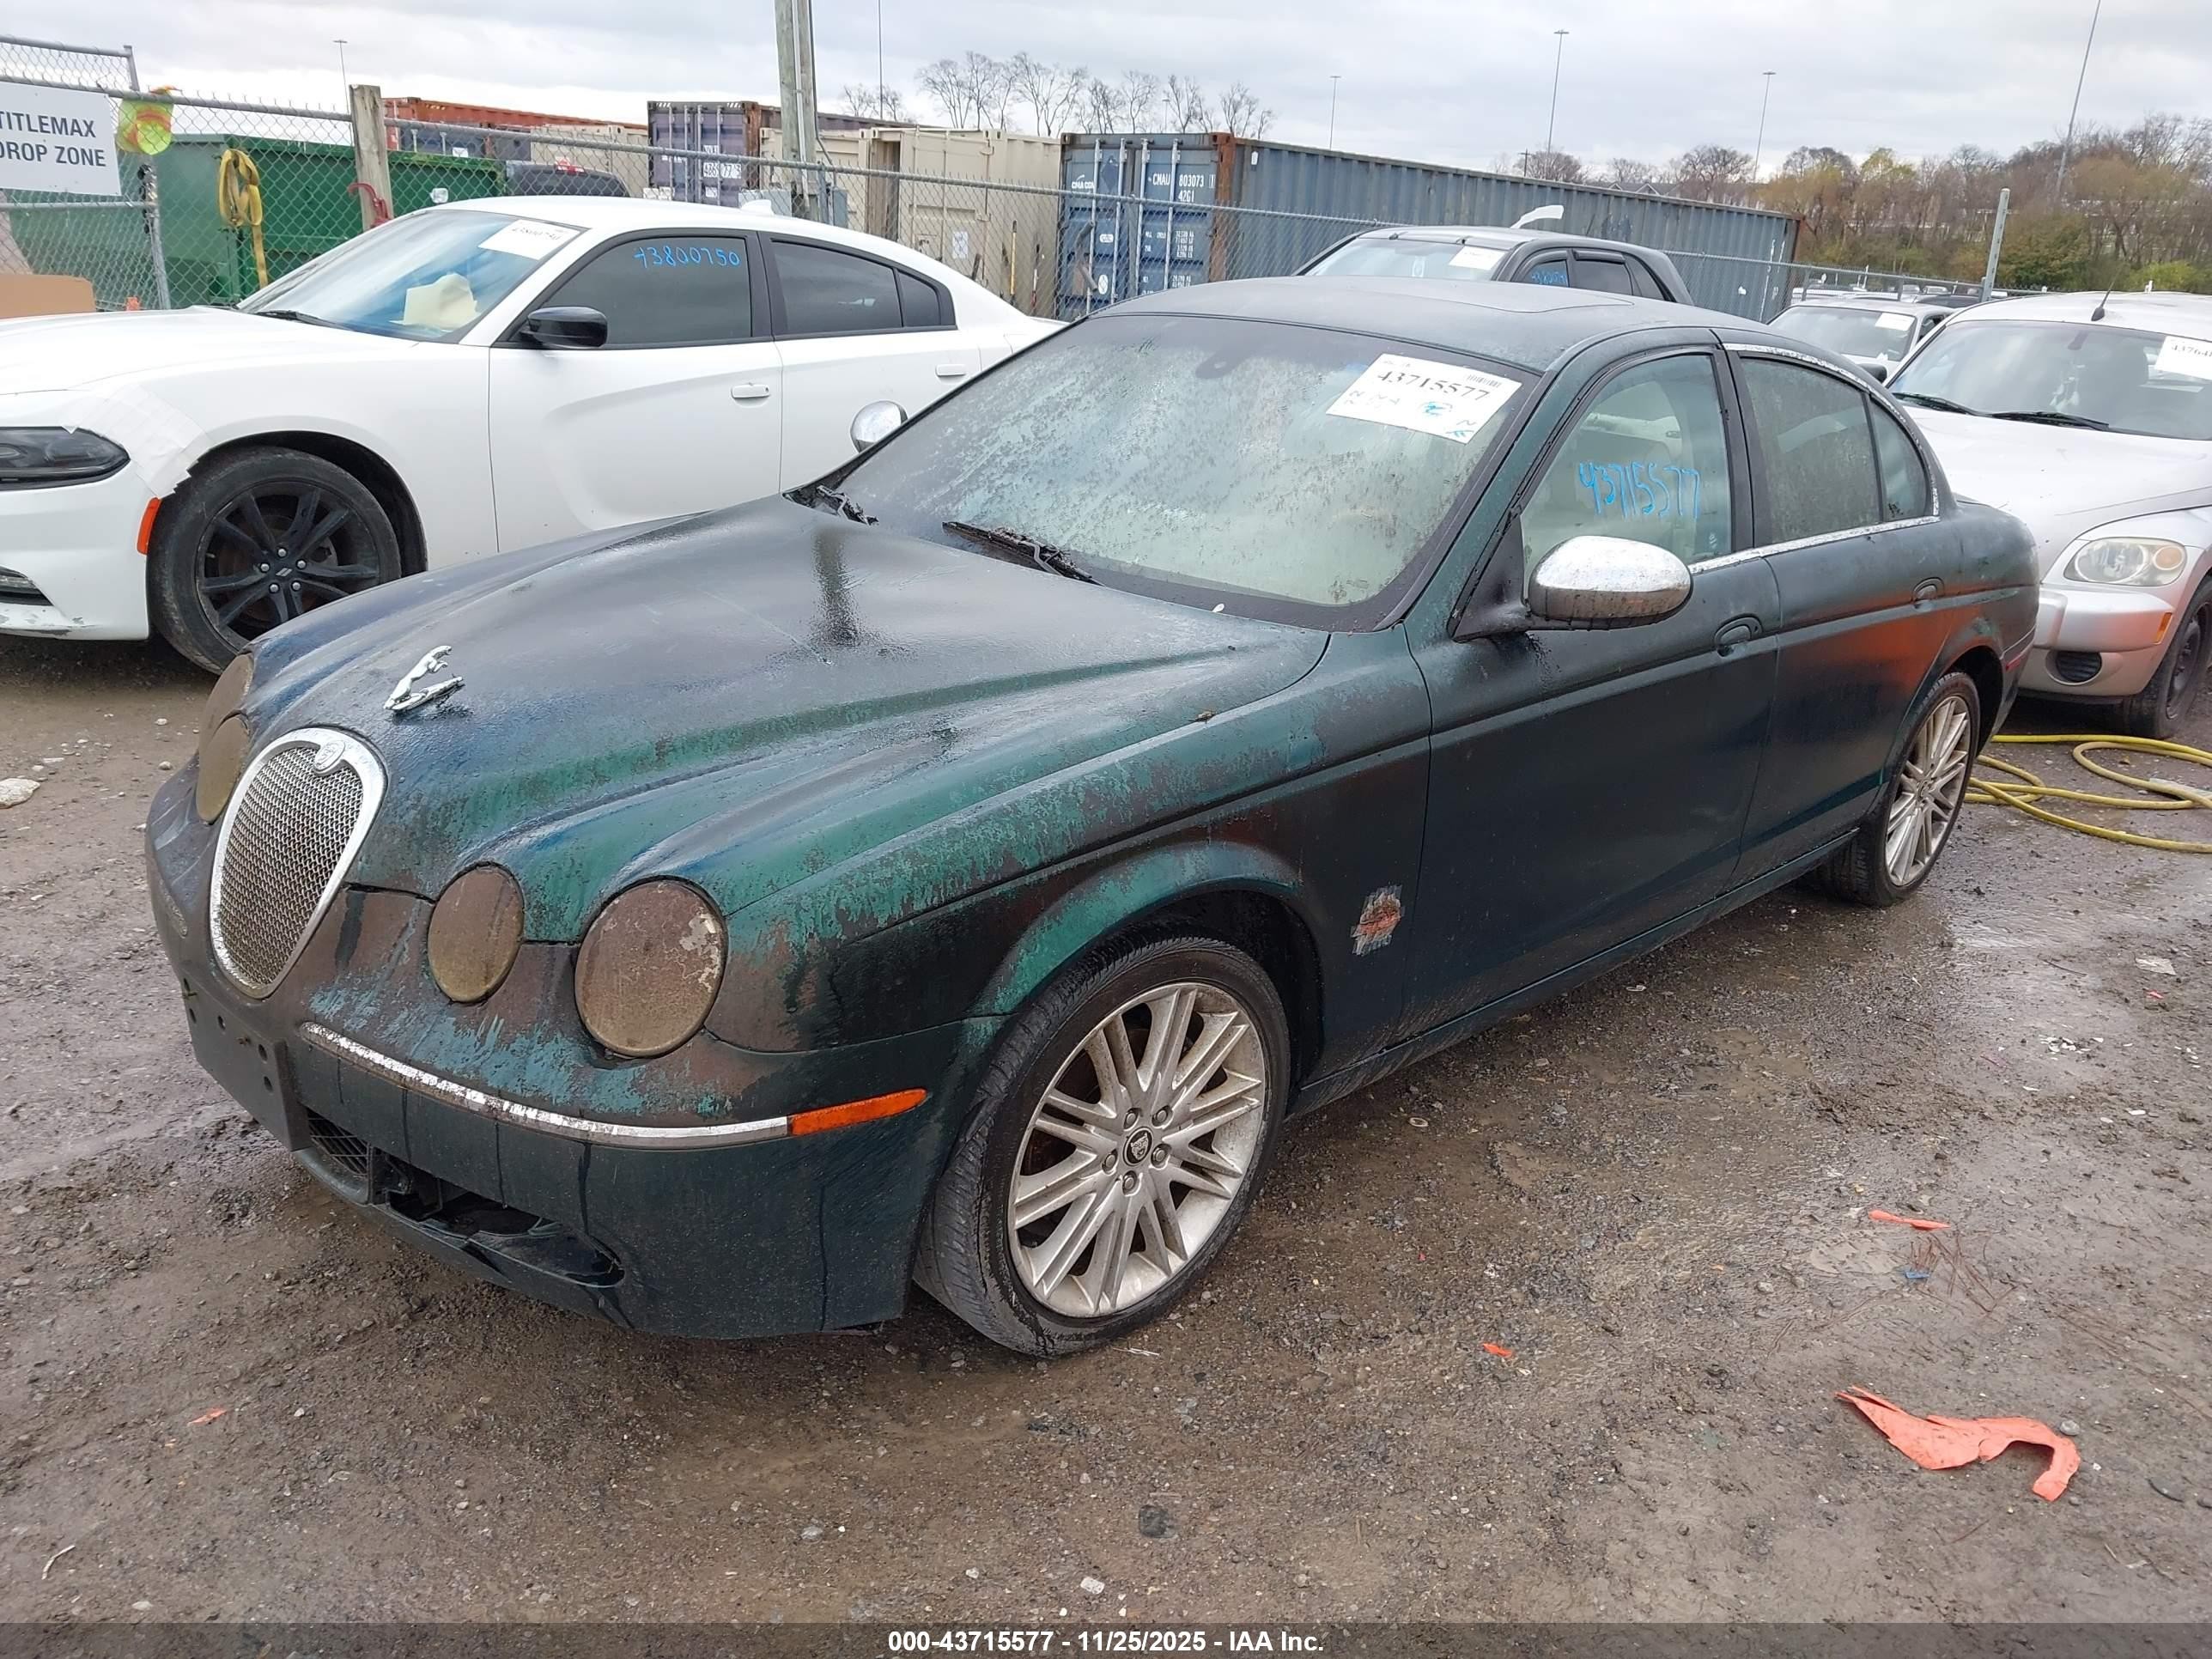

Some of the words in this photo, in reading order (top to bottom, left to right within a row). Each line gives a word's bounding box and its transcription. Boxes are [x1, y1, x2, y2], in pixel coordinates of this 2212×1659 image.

[54, 146, 106, 167] ZONE
[1179, 174, 1204, 187] 803073
[1377, 370, 1490, 400] 43715577
[1579, 462, 1699, 520] 43715577
